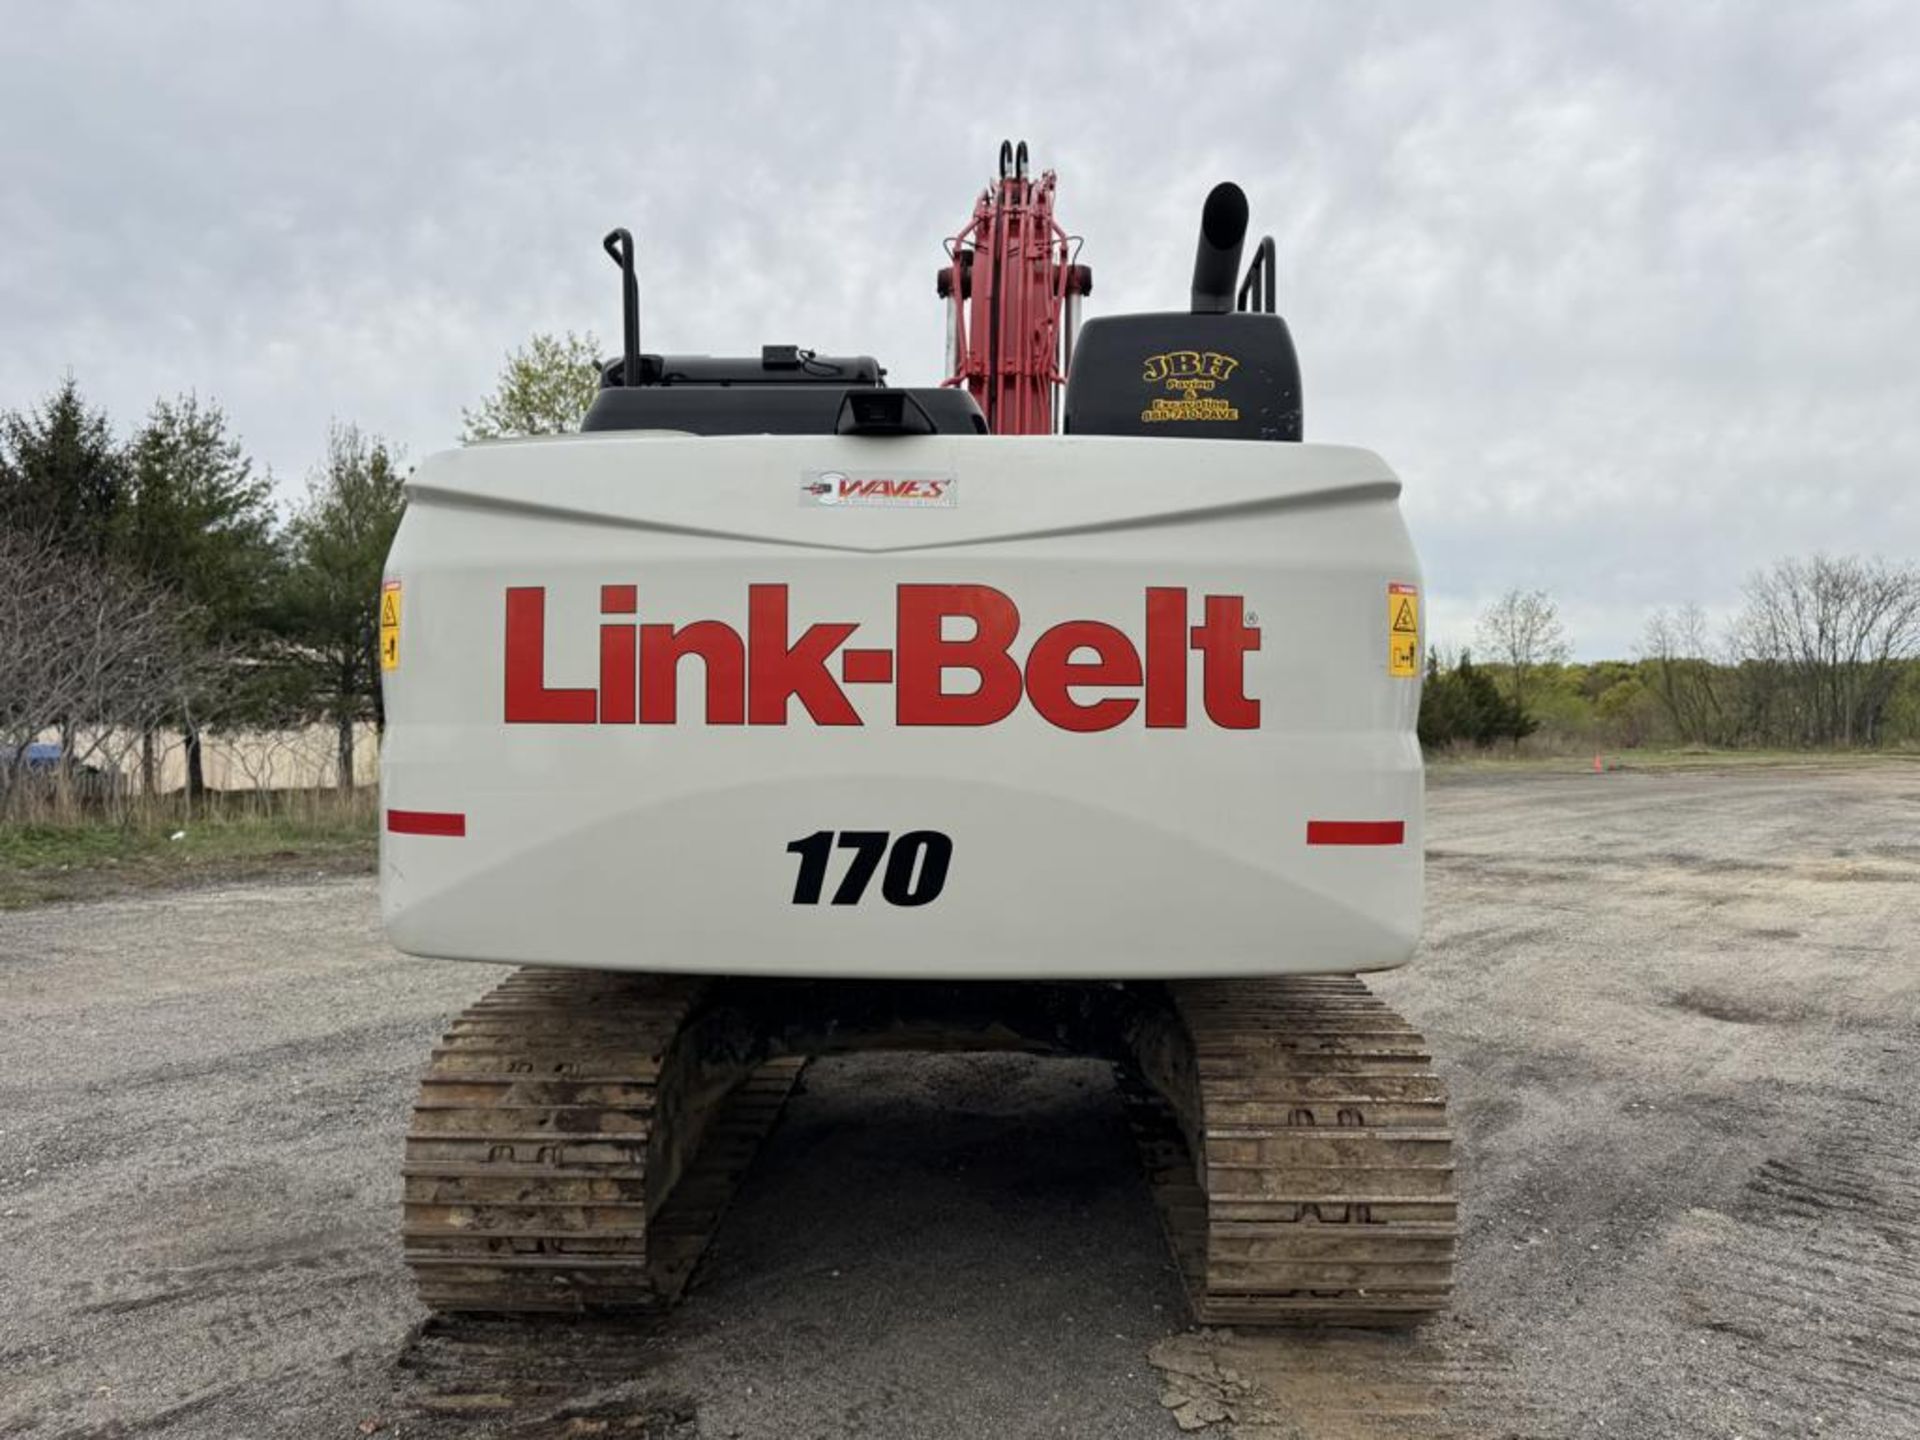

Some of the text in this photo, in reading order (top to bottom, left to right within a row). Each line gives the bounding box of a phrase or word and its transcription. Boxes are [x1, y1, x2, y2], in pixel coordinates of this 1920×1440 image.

[1143, 351, 1239, 381] JBH
[1166, 379, 1215, 391] Paving
[1153, 399, 1229, 411] Excavating
[839, 479, 951, 498] WAVES
[505, 583, 1261, 733] Link-Belt
[786, 830, 953, 908] 170
